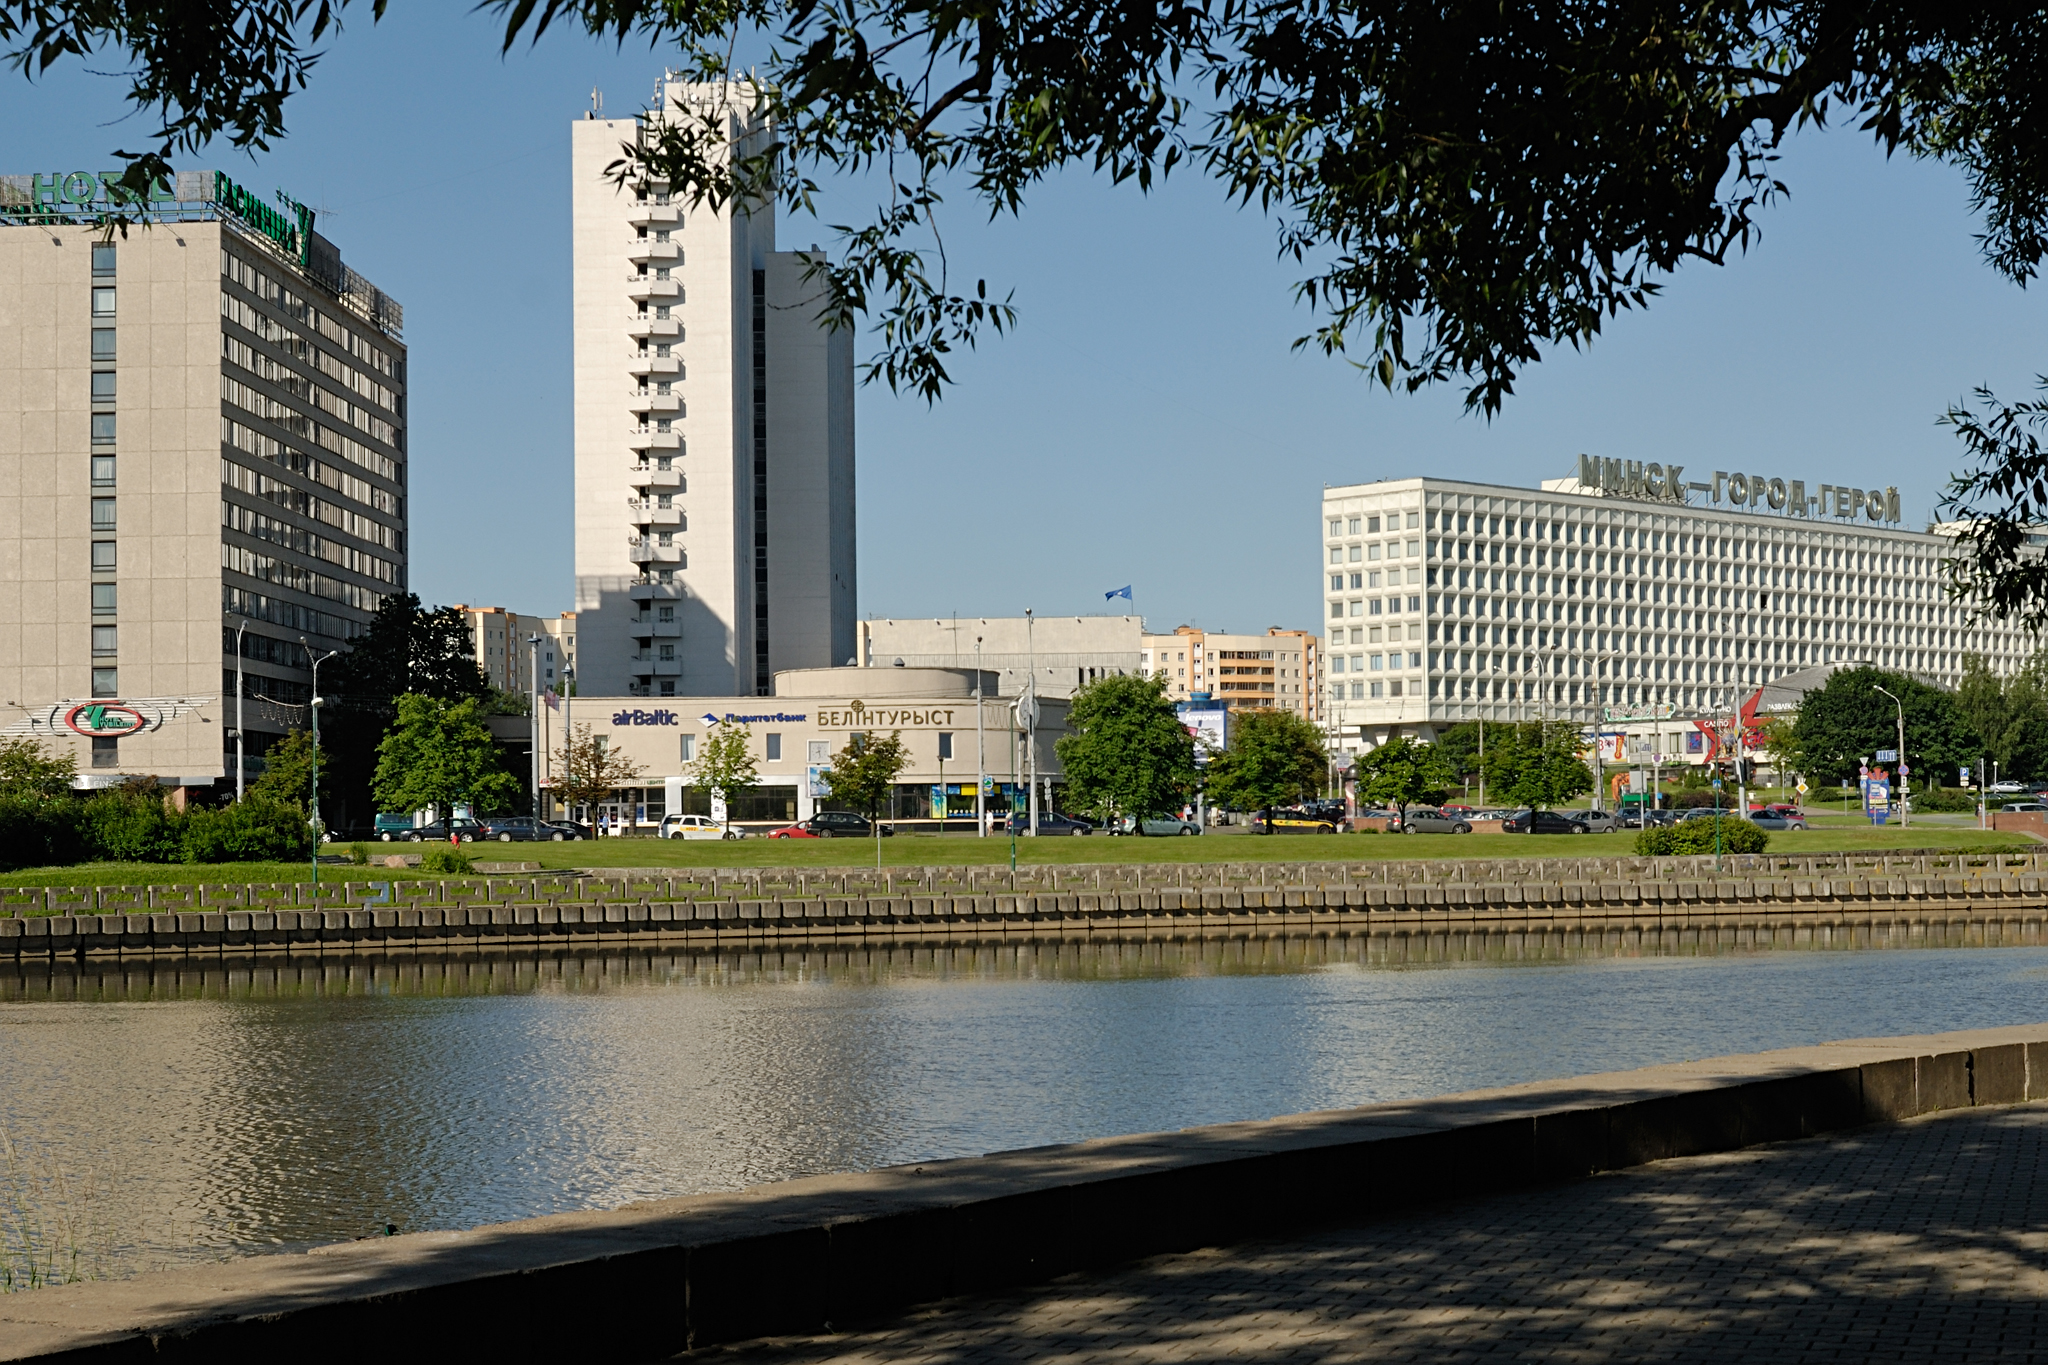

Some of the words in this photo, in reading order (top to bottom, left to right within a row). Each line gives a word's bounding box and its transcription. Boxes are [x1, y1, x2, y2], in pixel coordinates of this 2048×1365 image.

[34, 171, 174, 204] HOTL
[612, 709, 679, 726] airBaltic
[725, 713, 807, 724] Паритетбанк
[818, 704, 955, 726] БЕЛІНТУРЫСТ
[1185, 713, 1221, 721] lenovo
[1704, 720, 1729, 728] CASINO
